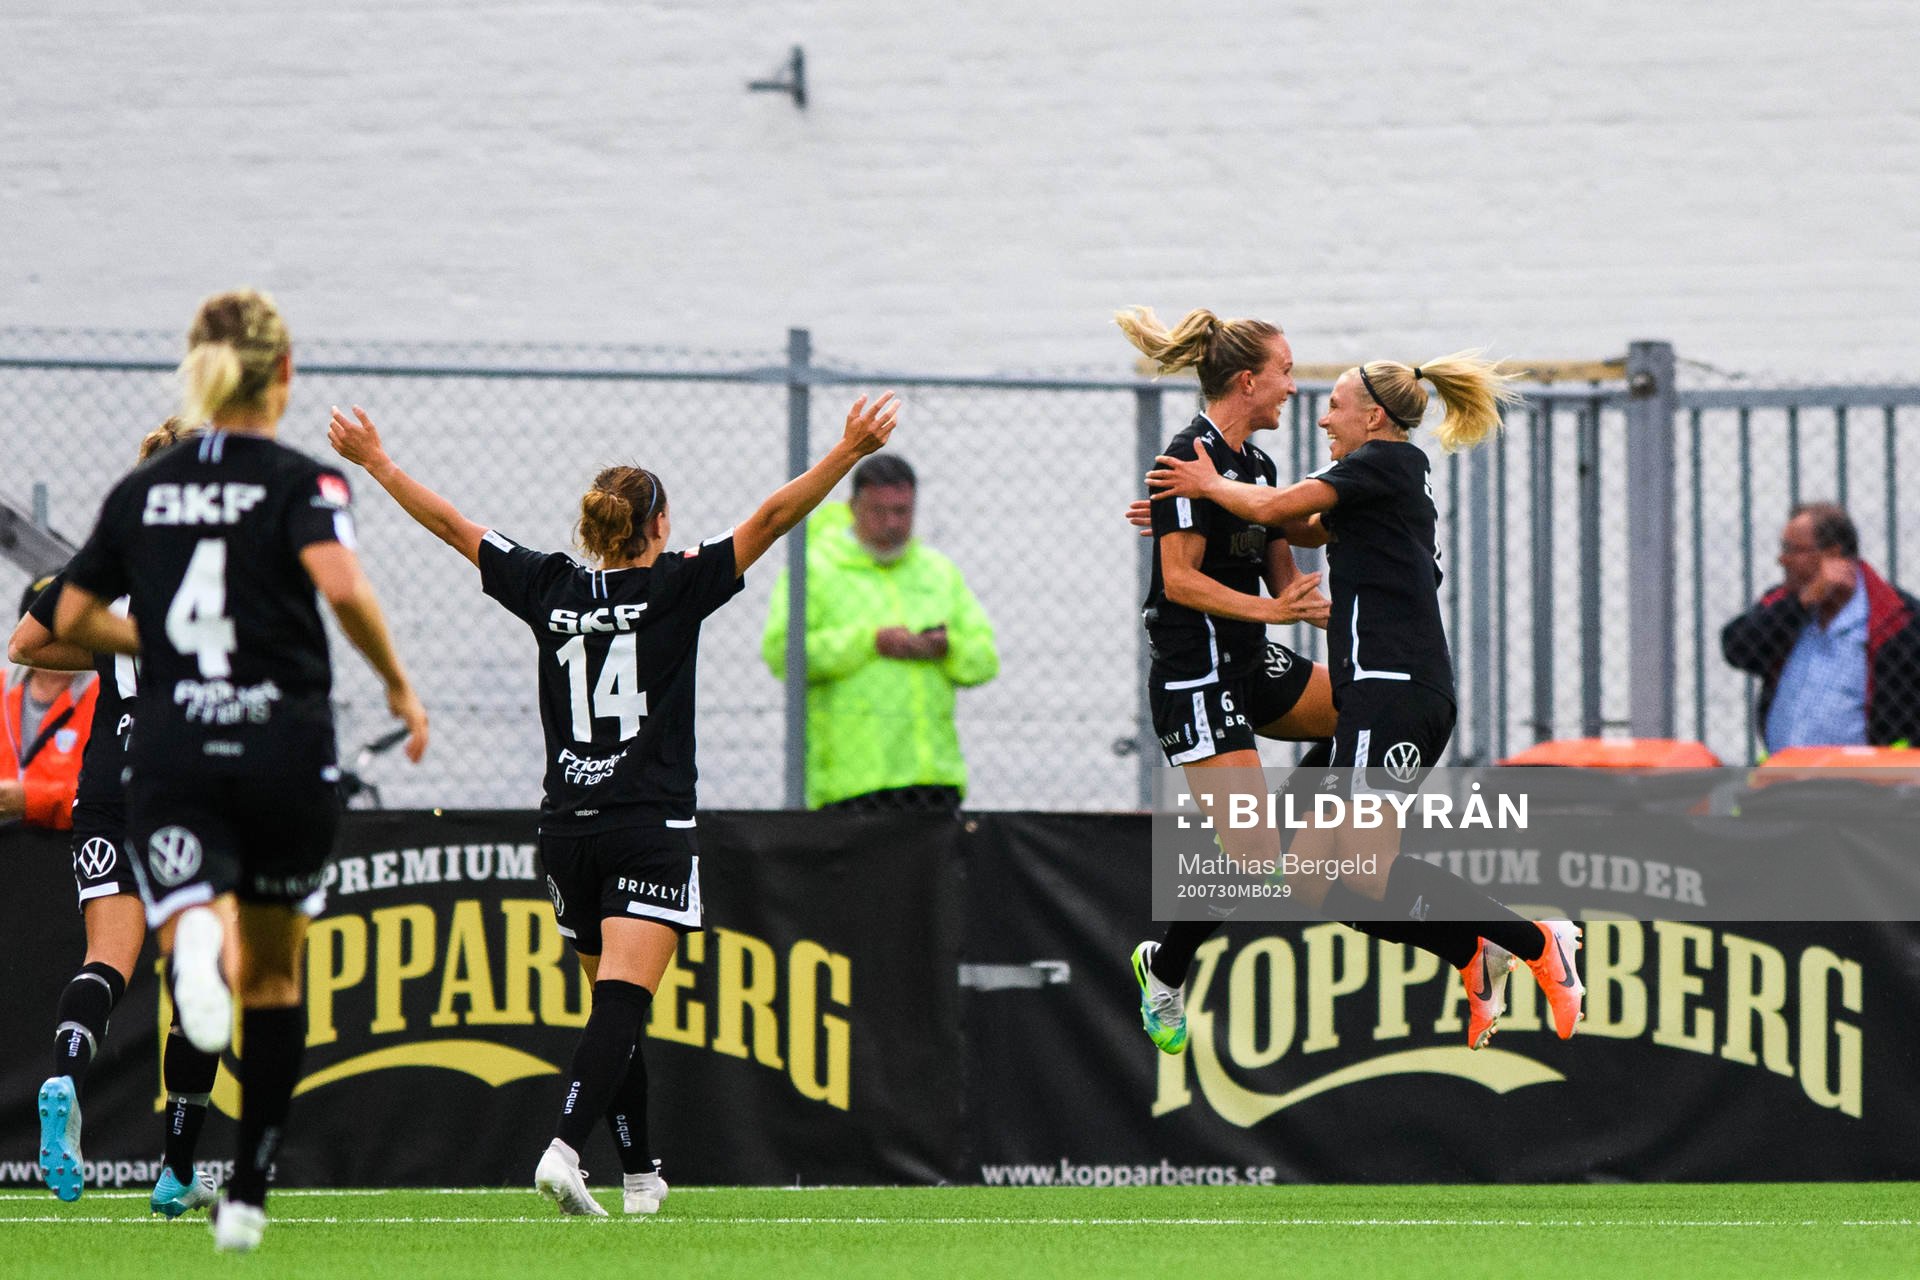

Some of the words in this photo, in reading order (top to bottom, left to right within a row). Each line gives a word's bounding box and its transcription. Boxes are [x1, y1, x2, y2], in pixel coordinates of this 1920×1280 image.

[143, 483, 266, 525] SKF
[165, 537, 237, 678] 4
[548, 602, 648, 634] SKF
[556, 632, 648, 743] 14
[1221, 690, 1234, 712] 6
[617, 876, 679, 901] BRIXLY
[1558, 851, 1707, 907] CIDER
[172, 1096, 188, 1136] umbro
[562, 1080, 581, 1115] umbro
[615, 1113, 632, 1148] umbro
